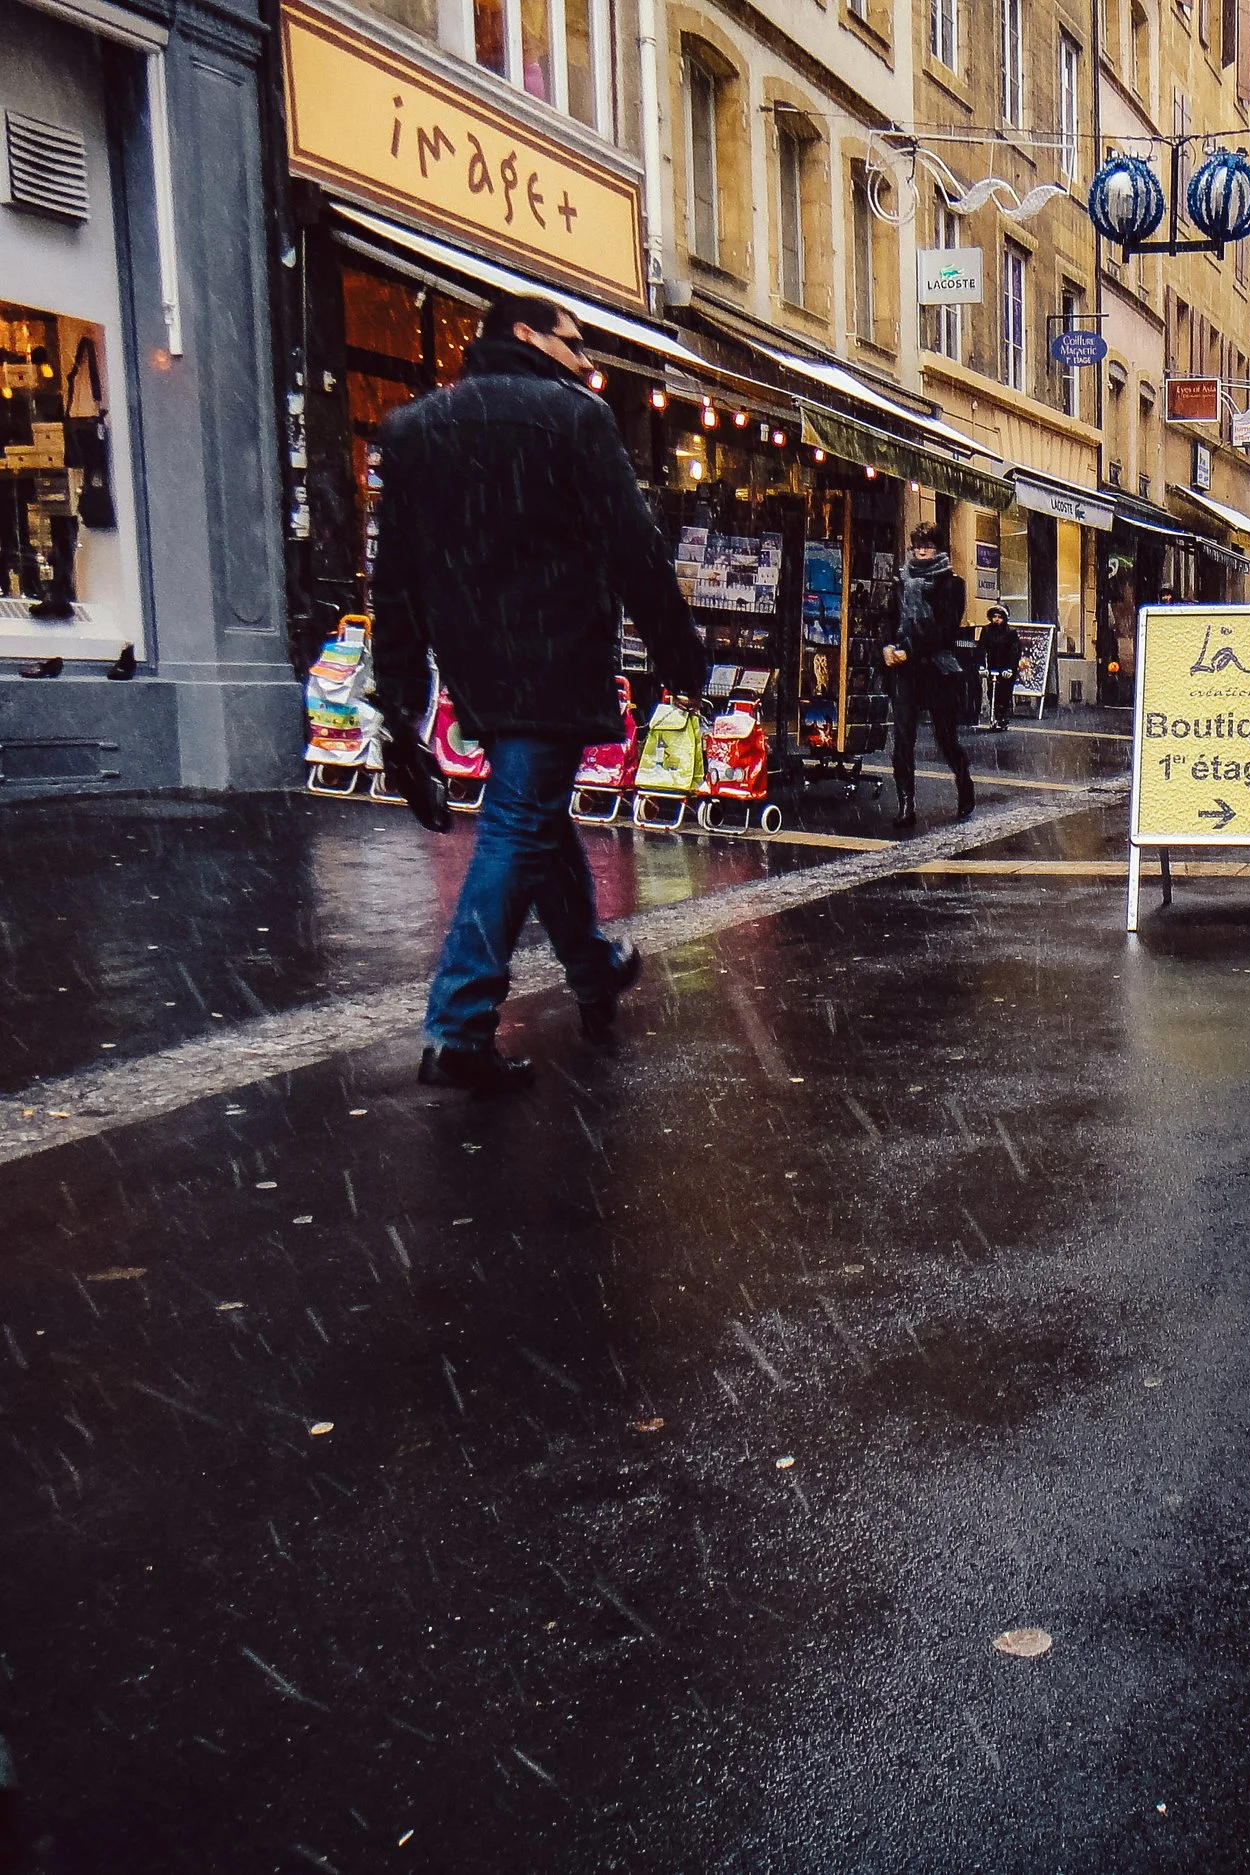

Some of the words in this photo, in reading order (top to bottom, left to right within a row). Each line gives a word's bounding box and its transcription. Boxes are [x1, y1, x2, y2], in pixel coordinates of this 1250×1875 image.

[927, 279, 976, 290] LACOSTE
[1176, 385, 1191, 394] Eyes
[1193, 385, 1200, 393] of
[1202, 384, 1217, 393] Asia
[1050, 498, 1073, 515] LACOSTE
[1158, 753, 1187, 781] 1er
